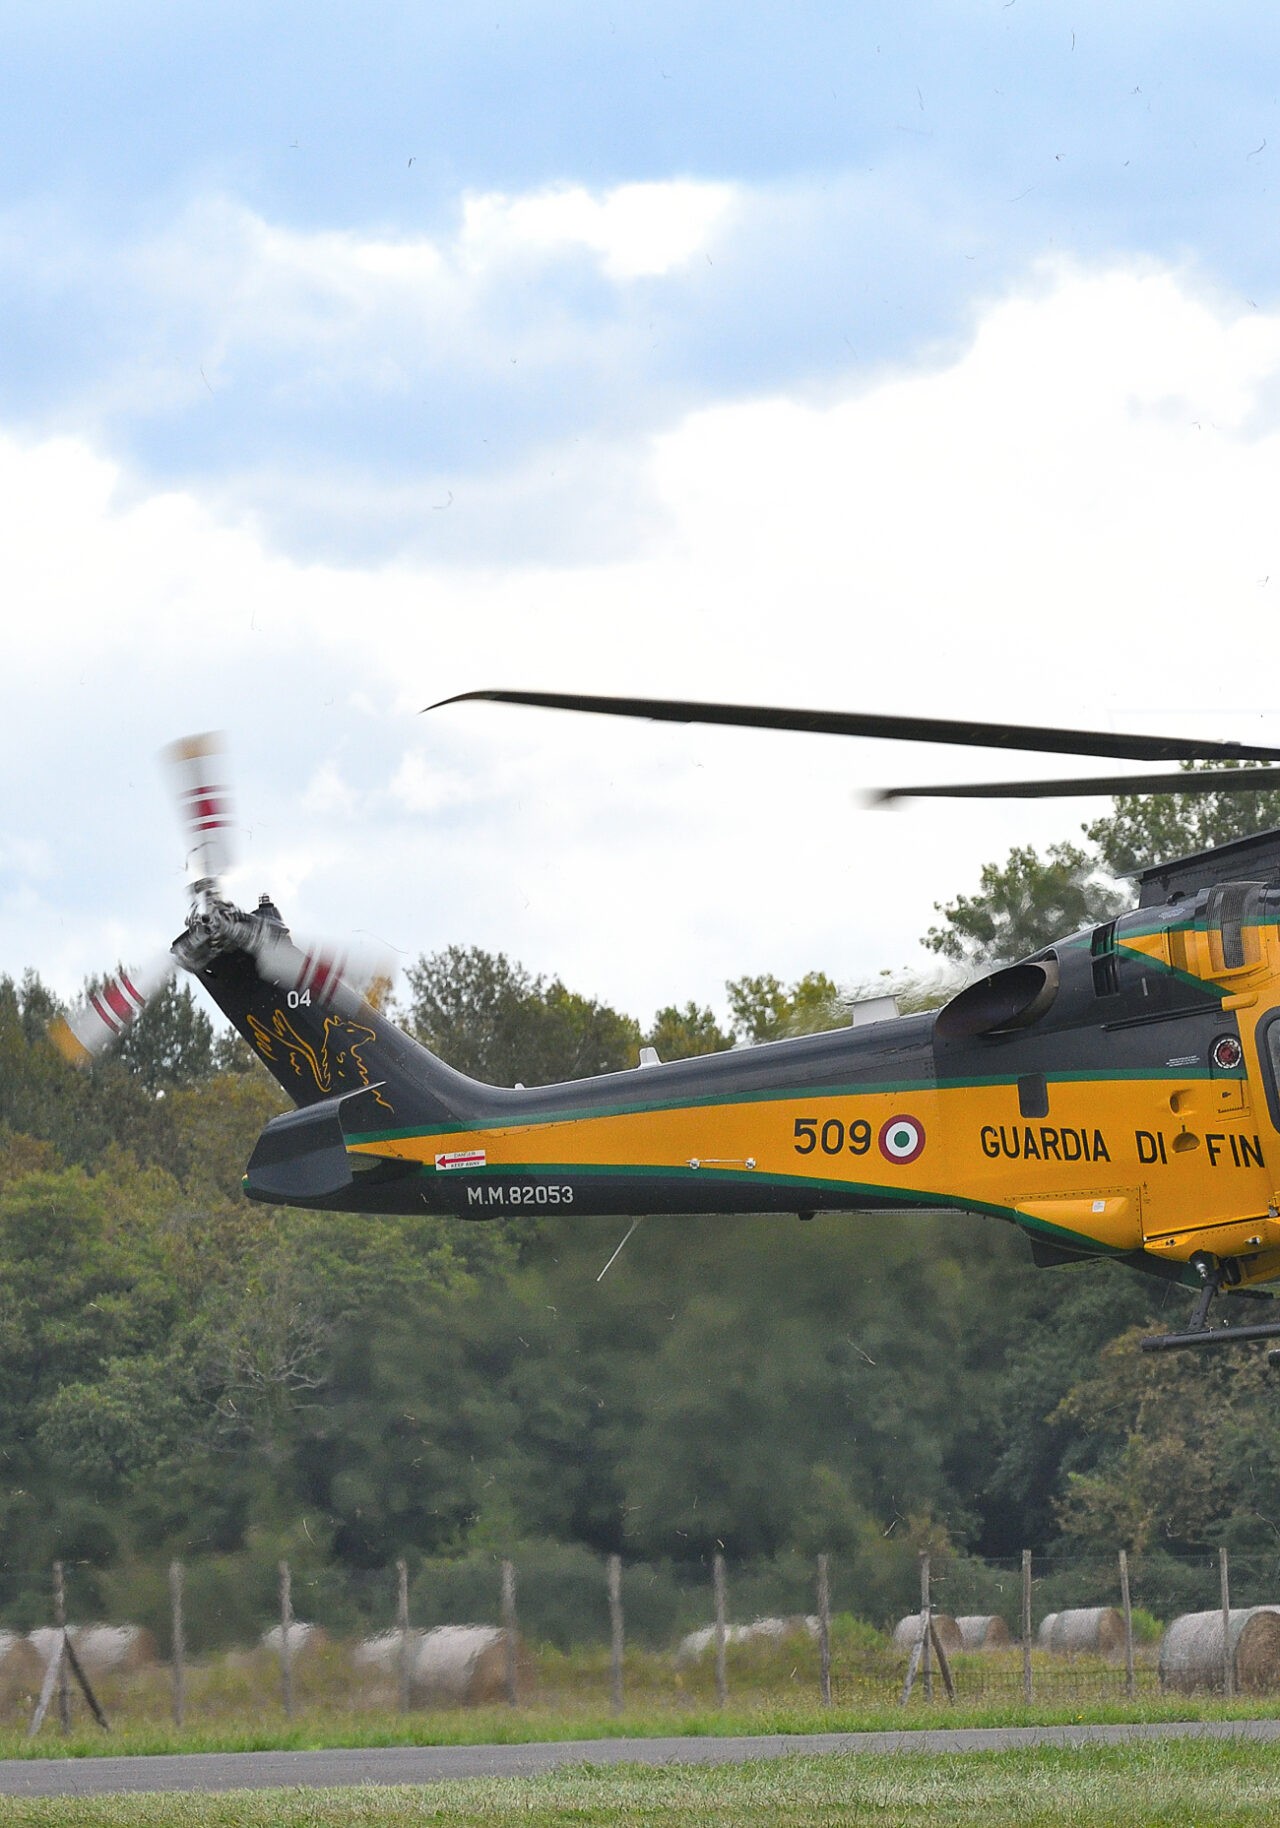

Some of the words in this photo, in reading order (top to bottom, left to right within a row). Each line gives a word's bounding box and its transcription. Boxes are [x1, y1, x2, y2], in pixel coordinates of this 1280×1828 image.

[286, 988, 312, 1009] 04
[793, 1117, 872, 1156] 509
[980, 1125, 1111, 1163] GUARDIA
[1137, 1130, 1168, 1165] DI
[1206, 1133, 1265, 1169] FIN
[467, 1185, 574, 1206] M.M.82053
